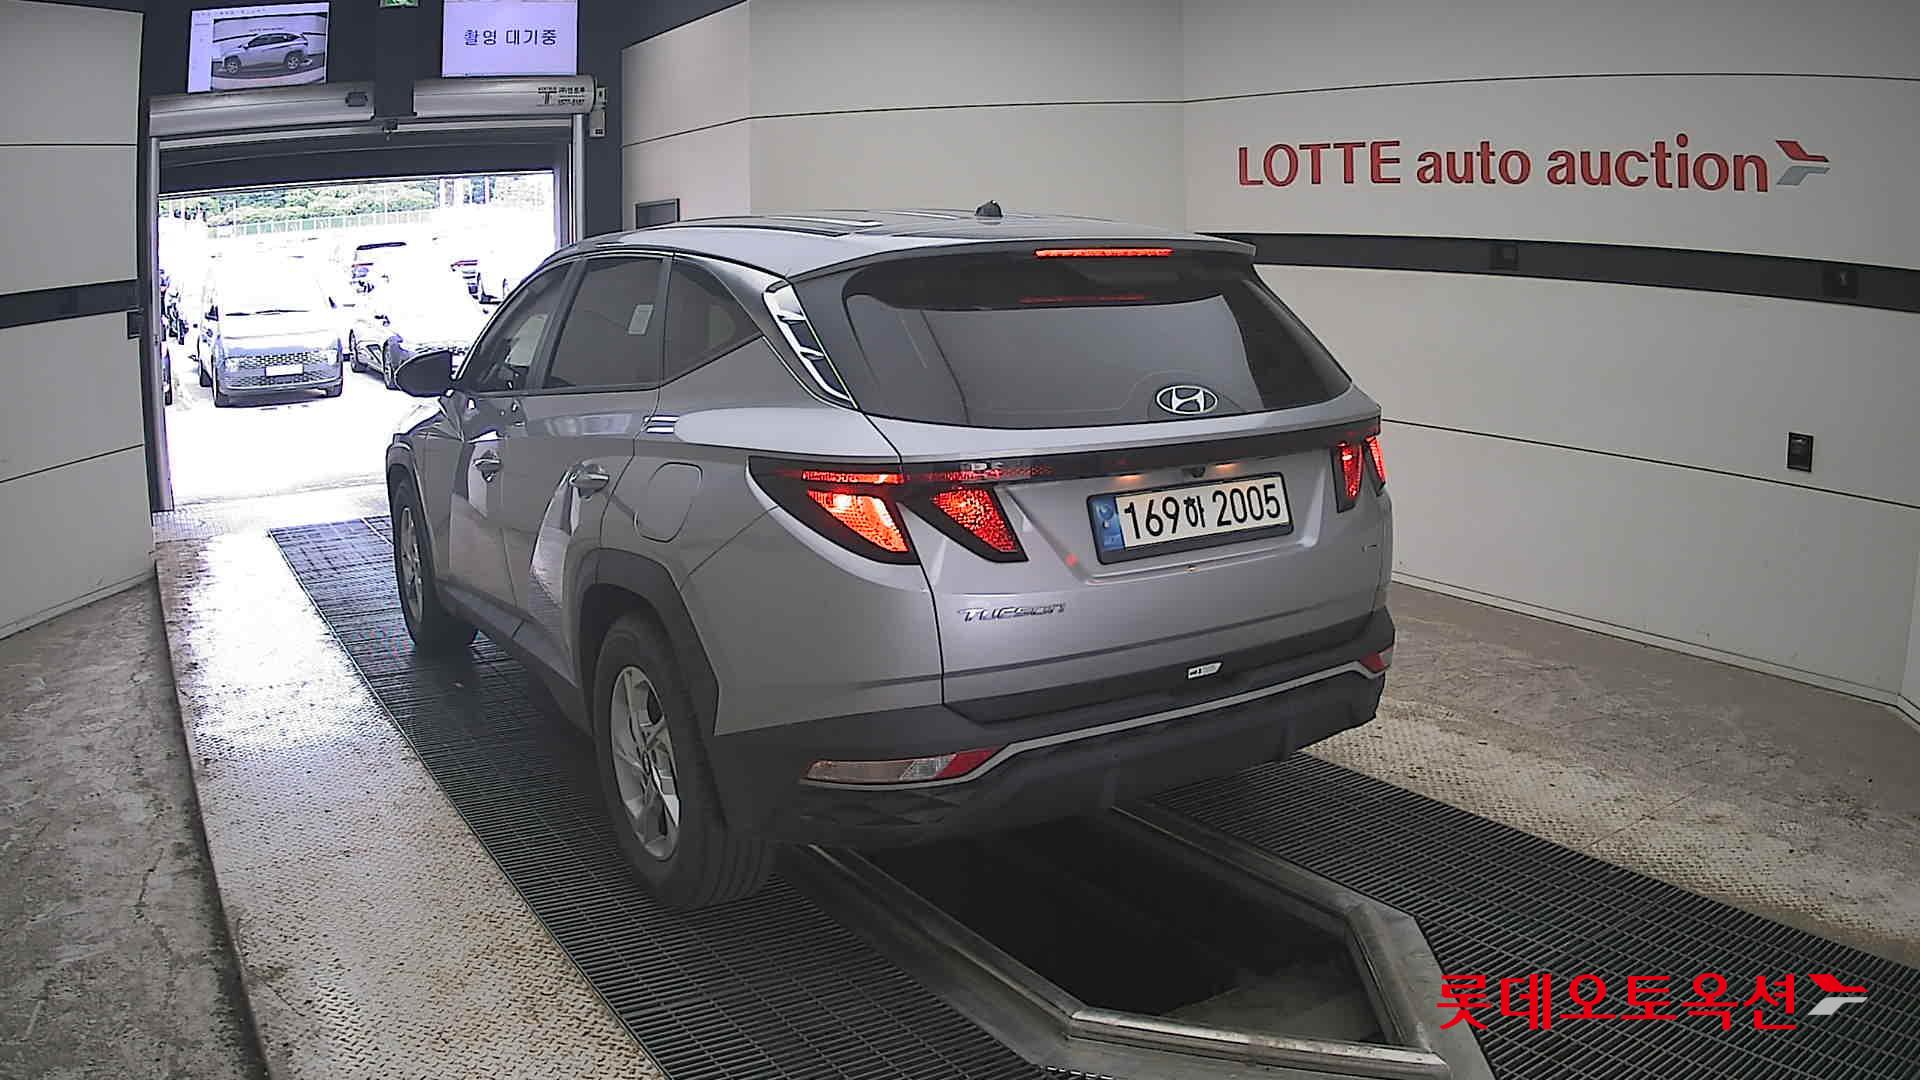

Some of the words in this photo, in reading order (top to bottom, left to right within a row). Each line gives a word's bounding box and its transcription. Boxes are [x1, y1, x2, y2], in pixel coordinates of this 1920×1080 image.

[465, 29, 496, 46] 촬영
[505, 29, 557, 46] 대기중
[1238, 141, 1400, 187] LOTTE
[1416, 140, 1531, 185] auto
[1546, 134, 1769, 193] auction
[1124, 495, 1205, 539] 169하
[1212, 483, 1281, 527] 2005
